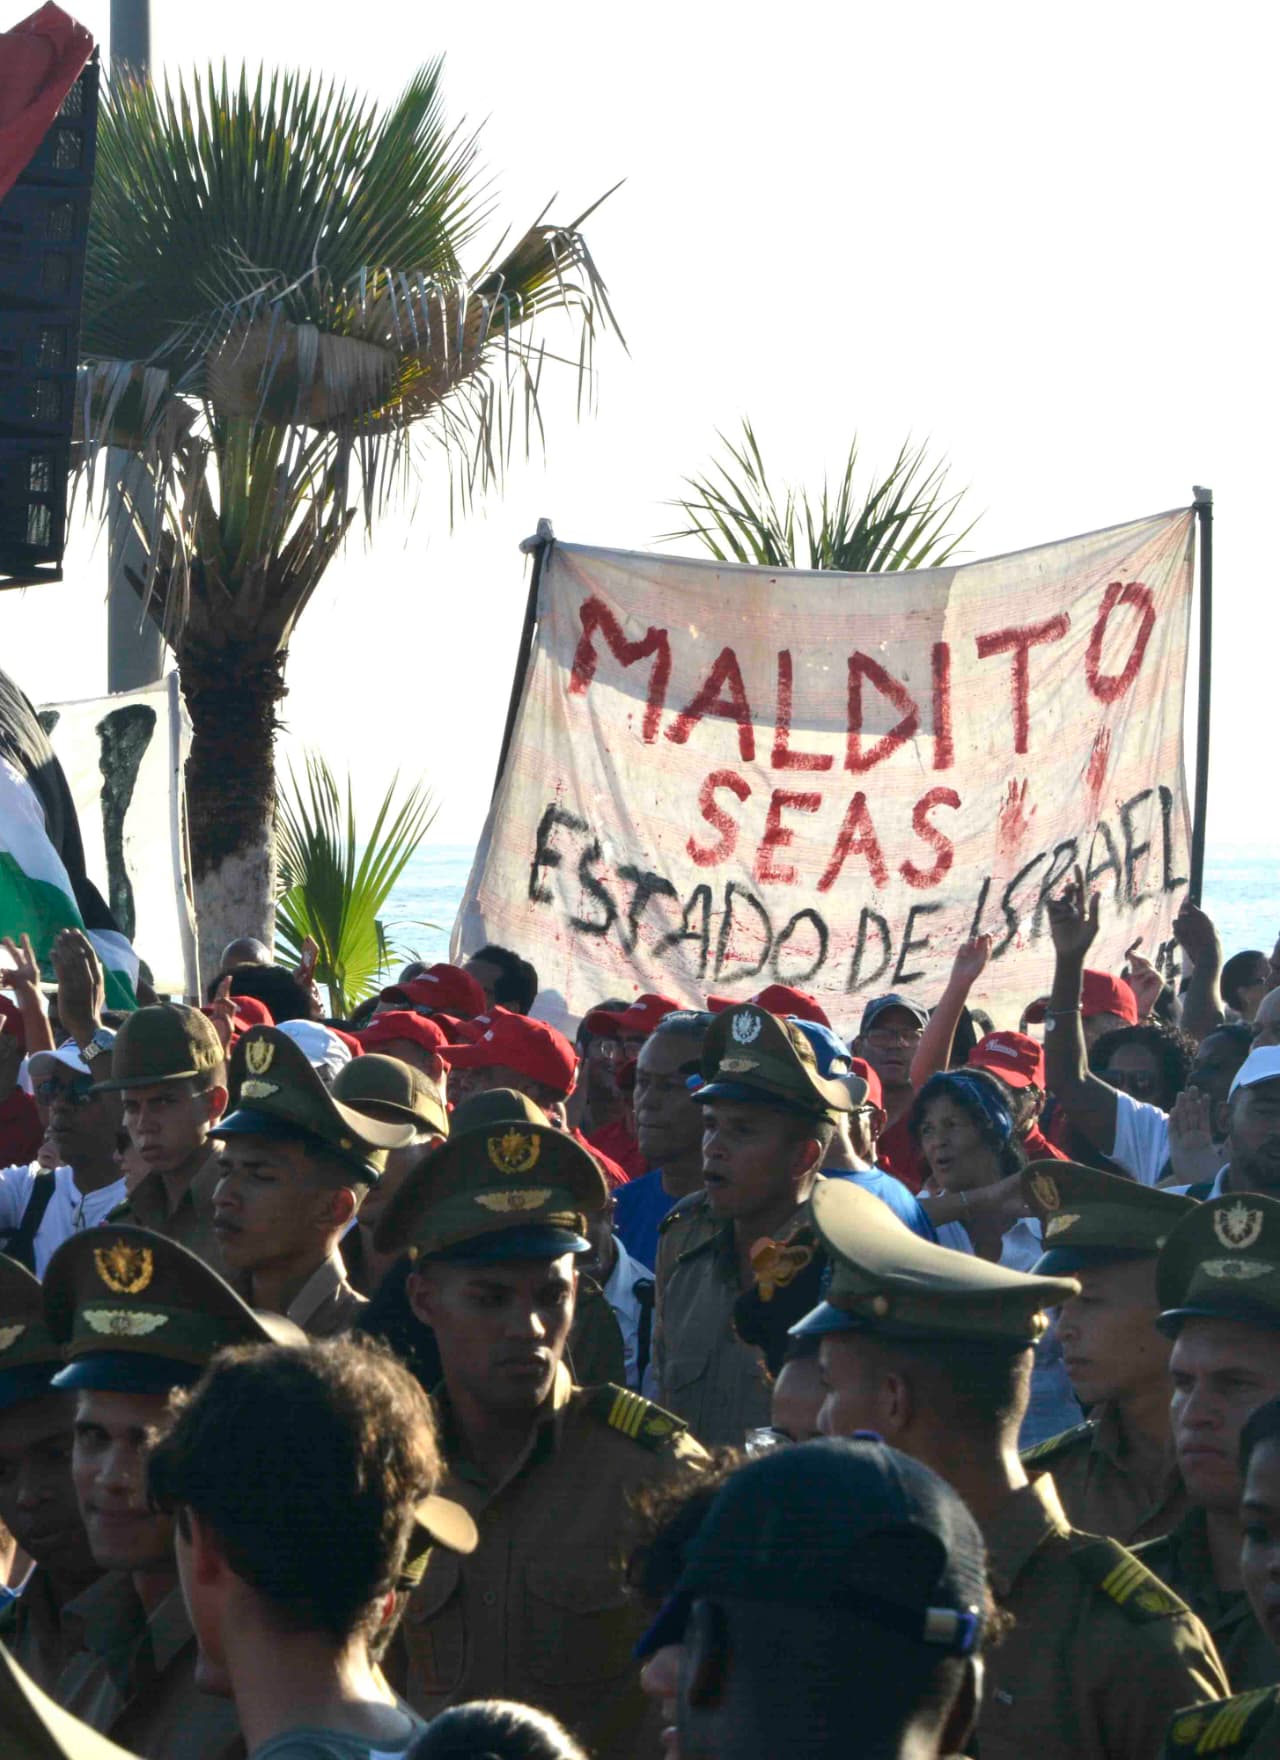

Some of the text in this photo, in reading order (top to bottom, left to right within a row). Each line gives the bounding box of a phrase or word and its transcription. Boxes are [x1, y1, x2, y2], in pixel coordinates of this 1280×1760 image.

[568, 582, 1157, 775] MALDITO
[528, 784, 1188, 993] ESTADO DE ISRAEL
[686, 770, 962, 893] SEAS
